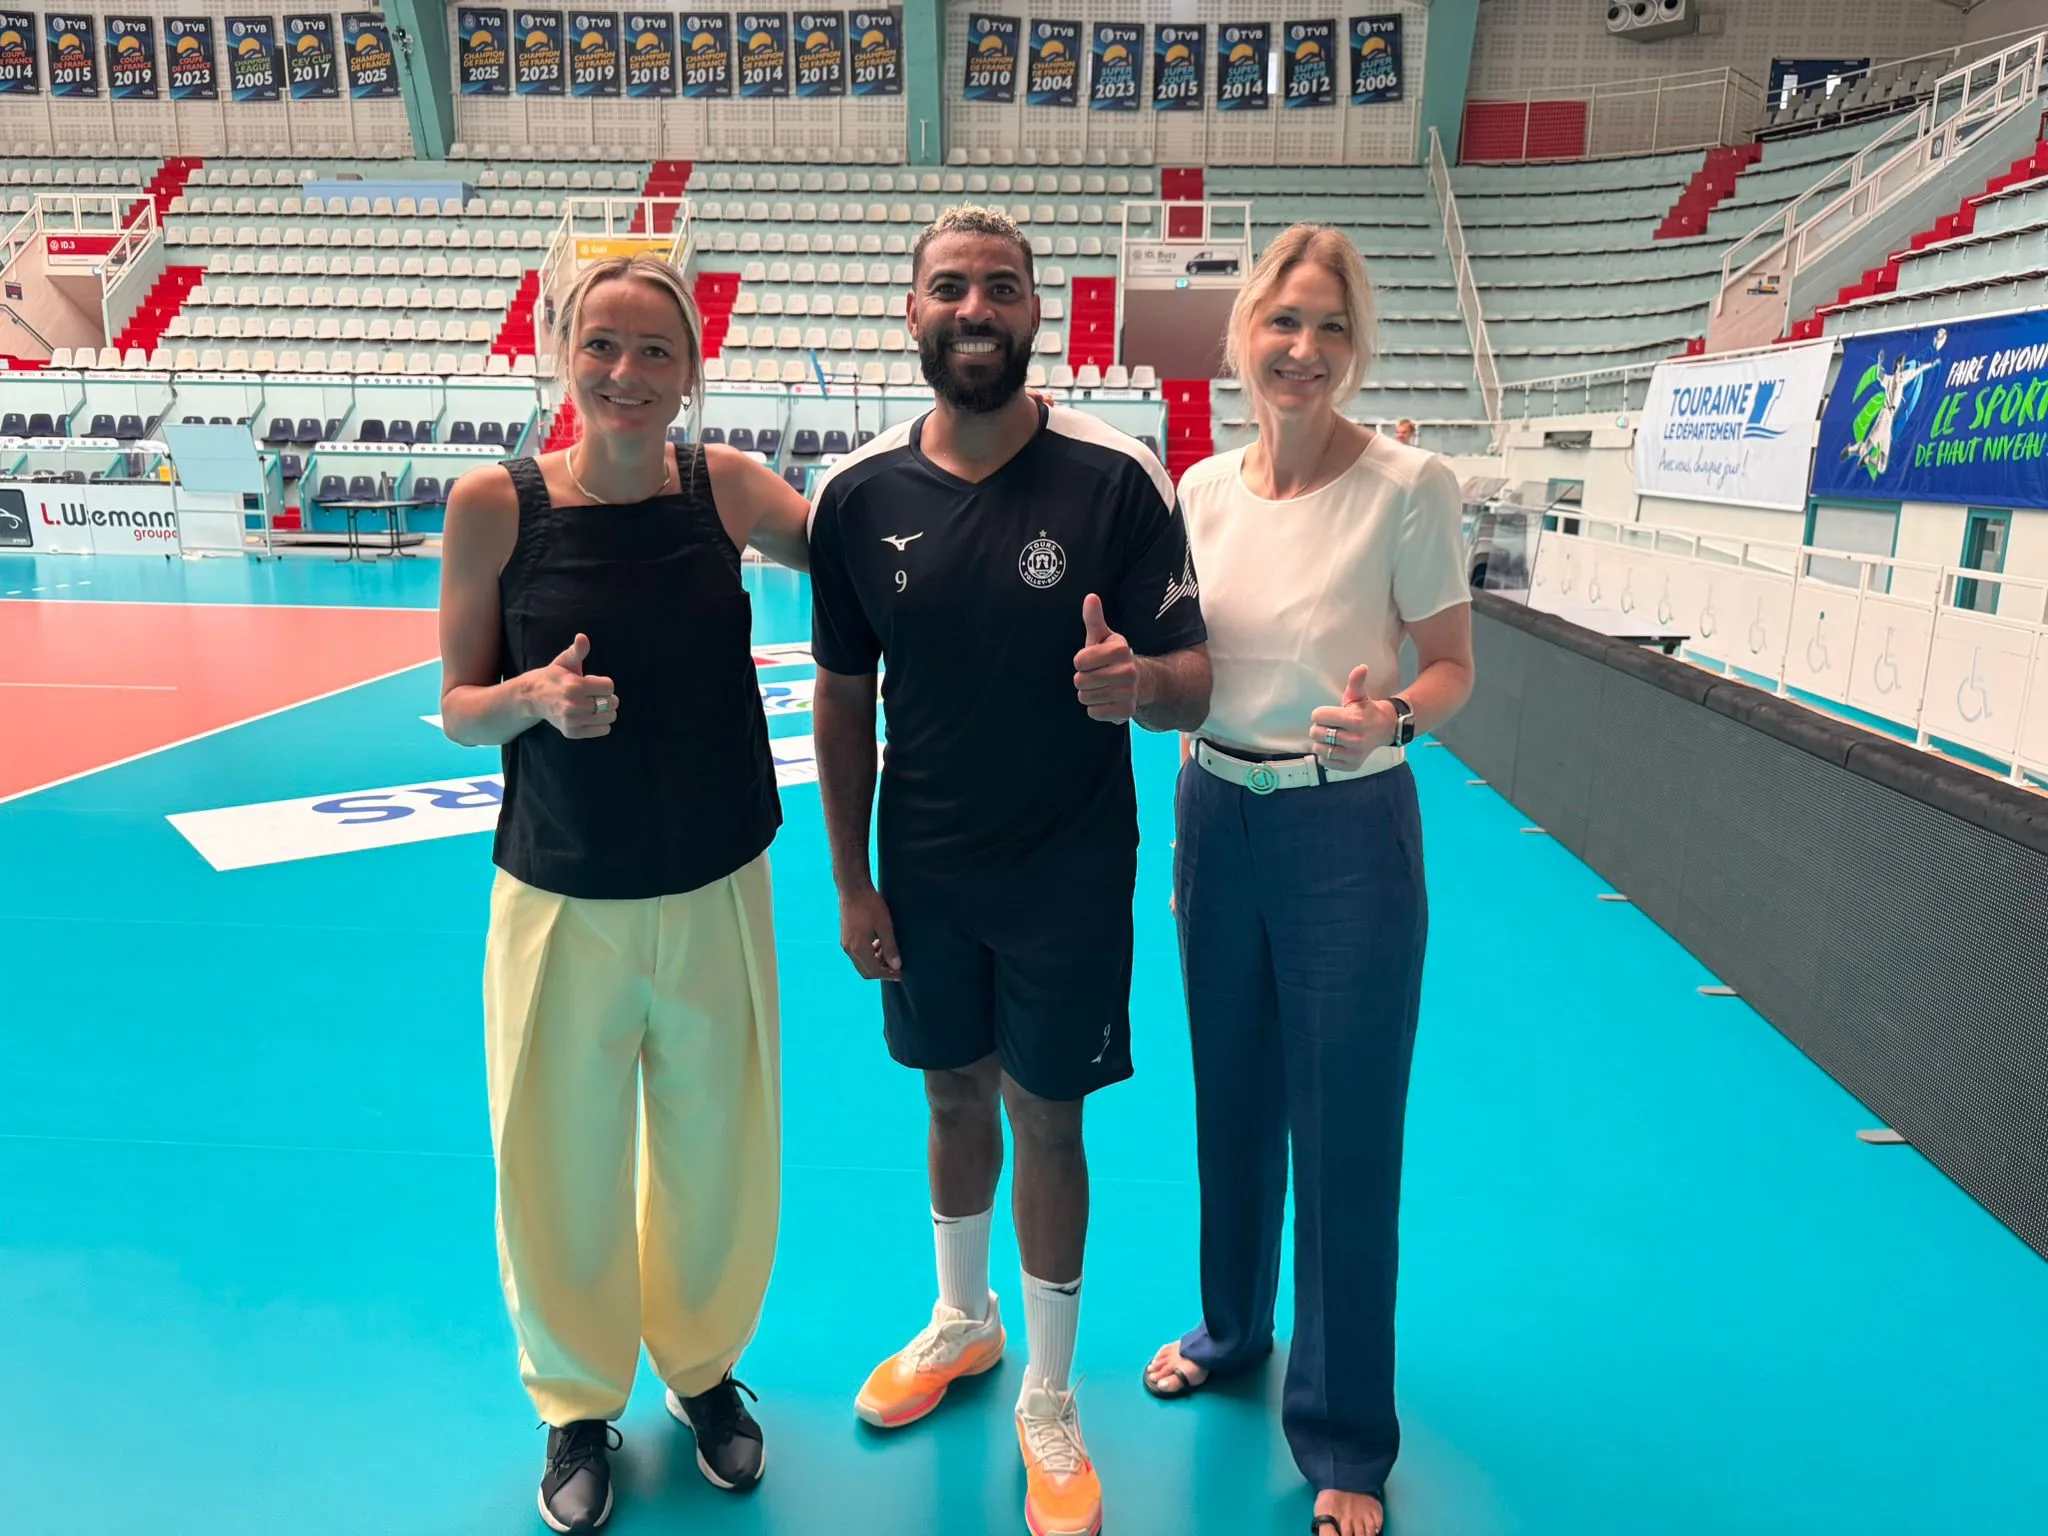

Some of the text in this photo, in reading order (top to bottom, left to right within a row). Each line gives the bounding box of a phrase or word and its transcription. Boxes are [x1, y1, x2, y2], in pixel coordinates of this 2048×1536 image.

[8, 18, 28, 27] TVB
[66, 19, 87, 30] TVB
[125, 21, 146, 32] TVB
[304, 21, 325, 31] TVB
[480, 17, 500, 27] TVB
[535, 17, 556, 27] TVB
[590, 18, 611, 28] TVB
[646, 19, 666, 29] TVB
[701, 19, 722, 29] TVB
[758, 18, 780, 29] TVB
[815, 17, 837, 28] TVB
[871, 16, 892, 26] TVB
[185, 22, 205, 33] TVB
[246, 24, 267, 33] TVB
[991, 22, 1012, 33] TVB
[1053, 27, 1074, 37] TVB
[1307, 27, 1328, 37] TVB
[1373, 22, 1394, 32] TVB
[1116, 31, 1137, 41] TVB
[1177, 31, 1199, 41] TVB
[1242, 31, 1263, 39] TVB
[5, 57, 33, 65] FRANCE
[60, 53, 84, 62] COUPE
[120, 55, 144, 63] COUPE
[179, 56, 204, 64] COUPE
[292, 55, 332, 67] CEV CUP
[351, 52, 391, 64] CHAMPION
[464, 51, 505, 60] CHAMPION
[474, 57, 504, 65] FRANCE
[520, 51, 560, 61] CHAMPION
[575, 52, 615, 62] CHAMPION
[630, 52, 671, 62] CHAMPION
[686, 52, 727, 64] CHAMPION
[743, 51, 784, 63] CHAMPION
[799, 50, 841, 63] CHAMPION
[855, 49, 896, 62] CHAMPION
[971, 56, 1014, 64] CHAMPION
[64, 60, 92, 68] FRANCE
[124, 62, 152, 70] FRANCE
[183, 62, 211, 71] FRANCE
[361, 59, 391, 70] FRANCE
[586, 59, 615, 67] FRANCE
[641, 59, 671, 67] FRANCE
[696, 59, 727, 68] FRANCE
[754, 58, 784, 67] FRANCE
[811, 58, 841, 67] FRANCE
[866, 57, 896, 67] FRANCE
[1032, 60, 1075, 69] CHAMPION
[1294, 62, 1326, 73] SUPER
[1361, 58, 1393, 69] SUPER
[0, 65, 33, 79] 2014
[236, 64, 271, 73] LEAGUE
[293, 64, 331, 82] 2017
[469, 67, 499, 81] 2025
[520, 66, 558, 82] 2023
[575, 66, 614, 82] 2019
[856, 65, 895, 83] 2012
[1043, 67, 1074, 75] FRANCE
[1102, 67, 1133, 76] SUPER
[1164, 66, 1195, 76] SUPER
[1228, 65, 1259, 75] SUPER
[1359, 66, 1392, 79] COUPE
[55, 68, 91, 84] 2015
[114, 70, 151, 86] 2019
[174, 70, 211, 86] 2023
[236, 71, 273, 88] 2005
[357, 69, 388, 85] 2025
[631, 67, 670, 84] 2018
[687, 67, 726, 84] 2015
[744, 67, 783, 84] 2014
[800, 66, 840, 84] 2013
[969, 72, 1010, 87] 2010
[1100, 74, 1132, 84] COUPE
[1162, 74, 1195, 85] COUPE
[1226, 73, 1259, 84] COUPE
[1293, 70, 1326, 82] COUPE
[1032, 76, 1073, 92] 2004
[1289, 78, 1330, 97] 2012
[1356, 73, 1397, 94] 2006
[1096, 83, 1135, 99] 2023
[1158, 82, 1198, 99] 2015
[1223, 81, 1263, 100] 2014
[61, 241, 75, 249] ID.3
[1945, 343, 2048, 388] FAIRE RAYON
[1671, 383, 1753, 417] TOURAINE
[1930, 377, 2048, 439] LE SPORT
[1664, 418, 1743, 440] LE DÉPARTEMENT
[1915, 432, 2047, 468] DE HAUT NIVEAU
[1029, 542, 1057, 551] TOURS
[895, 570, 907, 593] 9
[312, 781, 505, 825] RS
